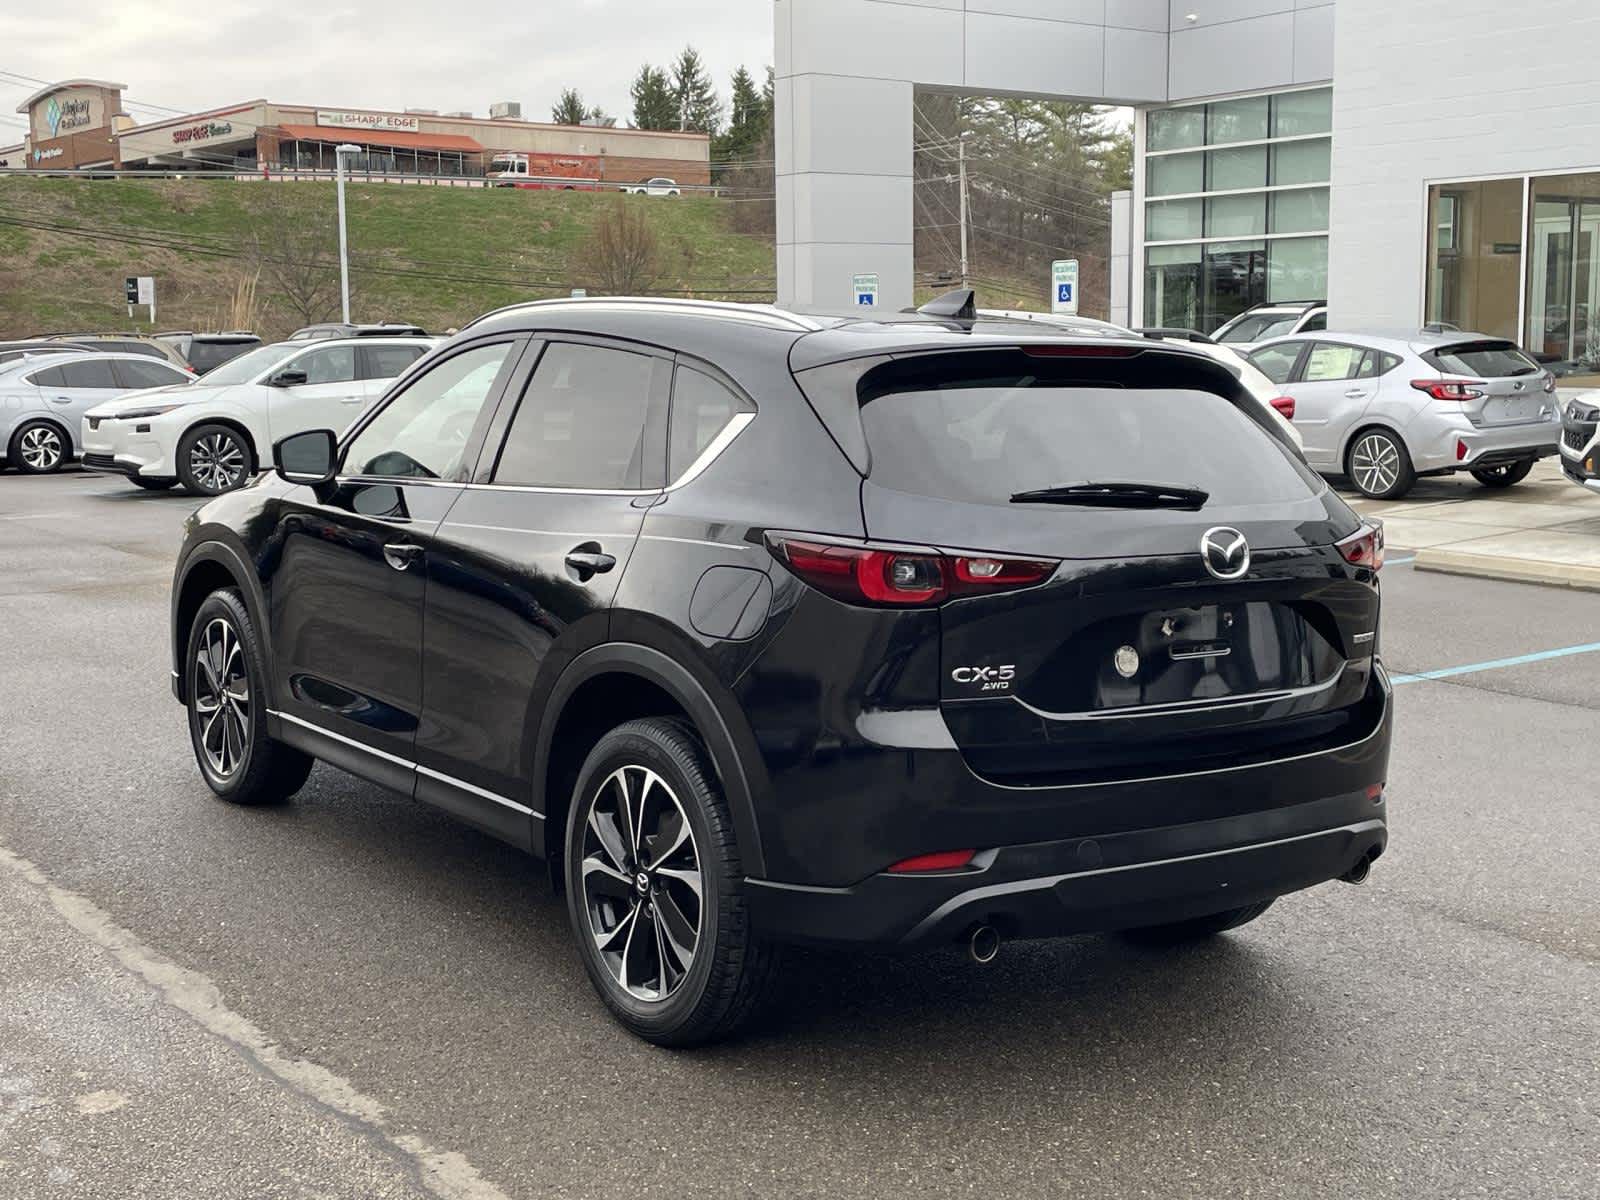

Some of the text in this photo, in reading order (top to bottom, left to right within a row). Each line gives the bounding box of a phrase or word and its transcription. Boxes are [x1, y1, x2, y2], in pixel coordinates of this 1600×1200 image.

[344, 113, 383, 125] SHARP
[387, 117, 417, 128] EDGE
[951, 664, 1016, 683] CX-5
[981, 682, 1009, 691] AWD
